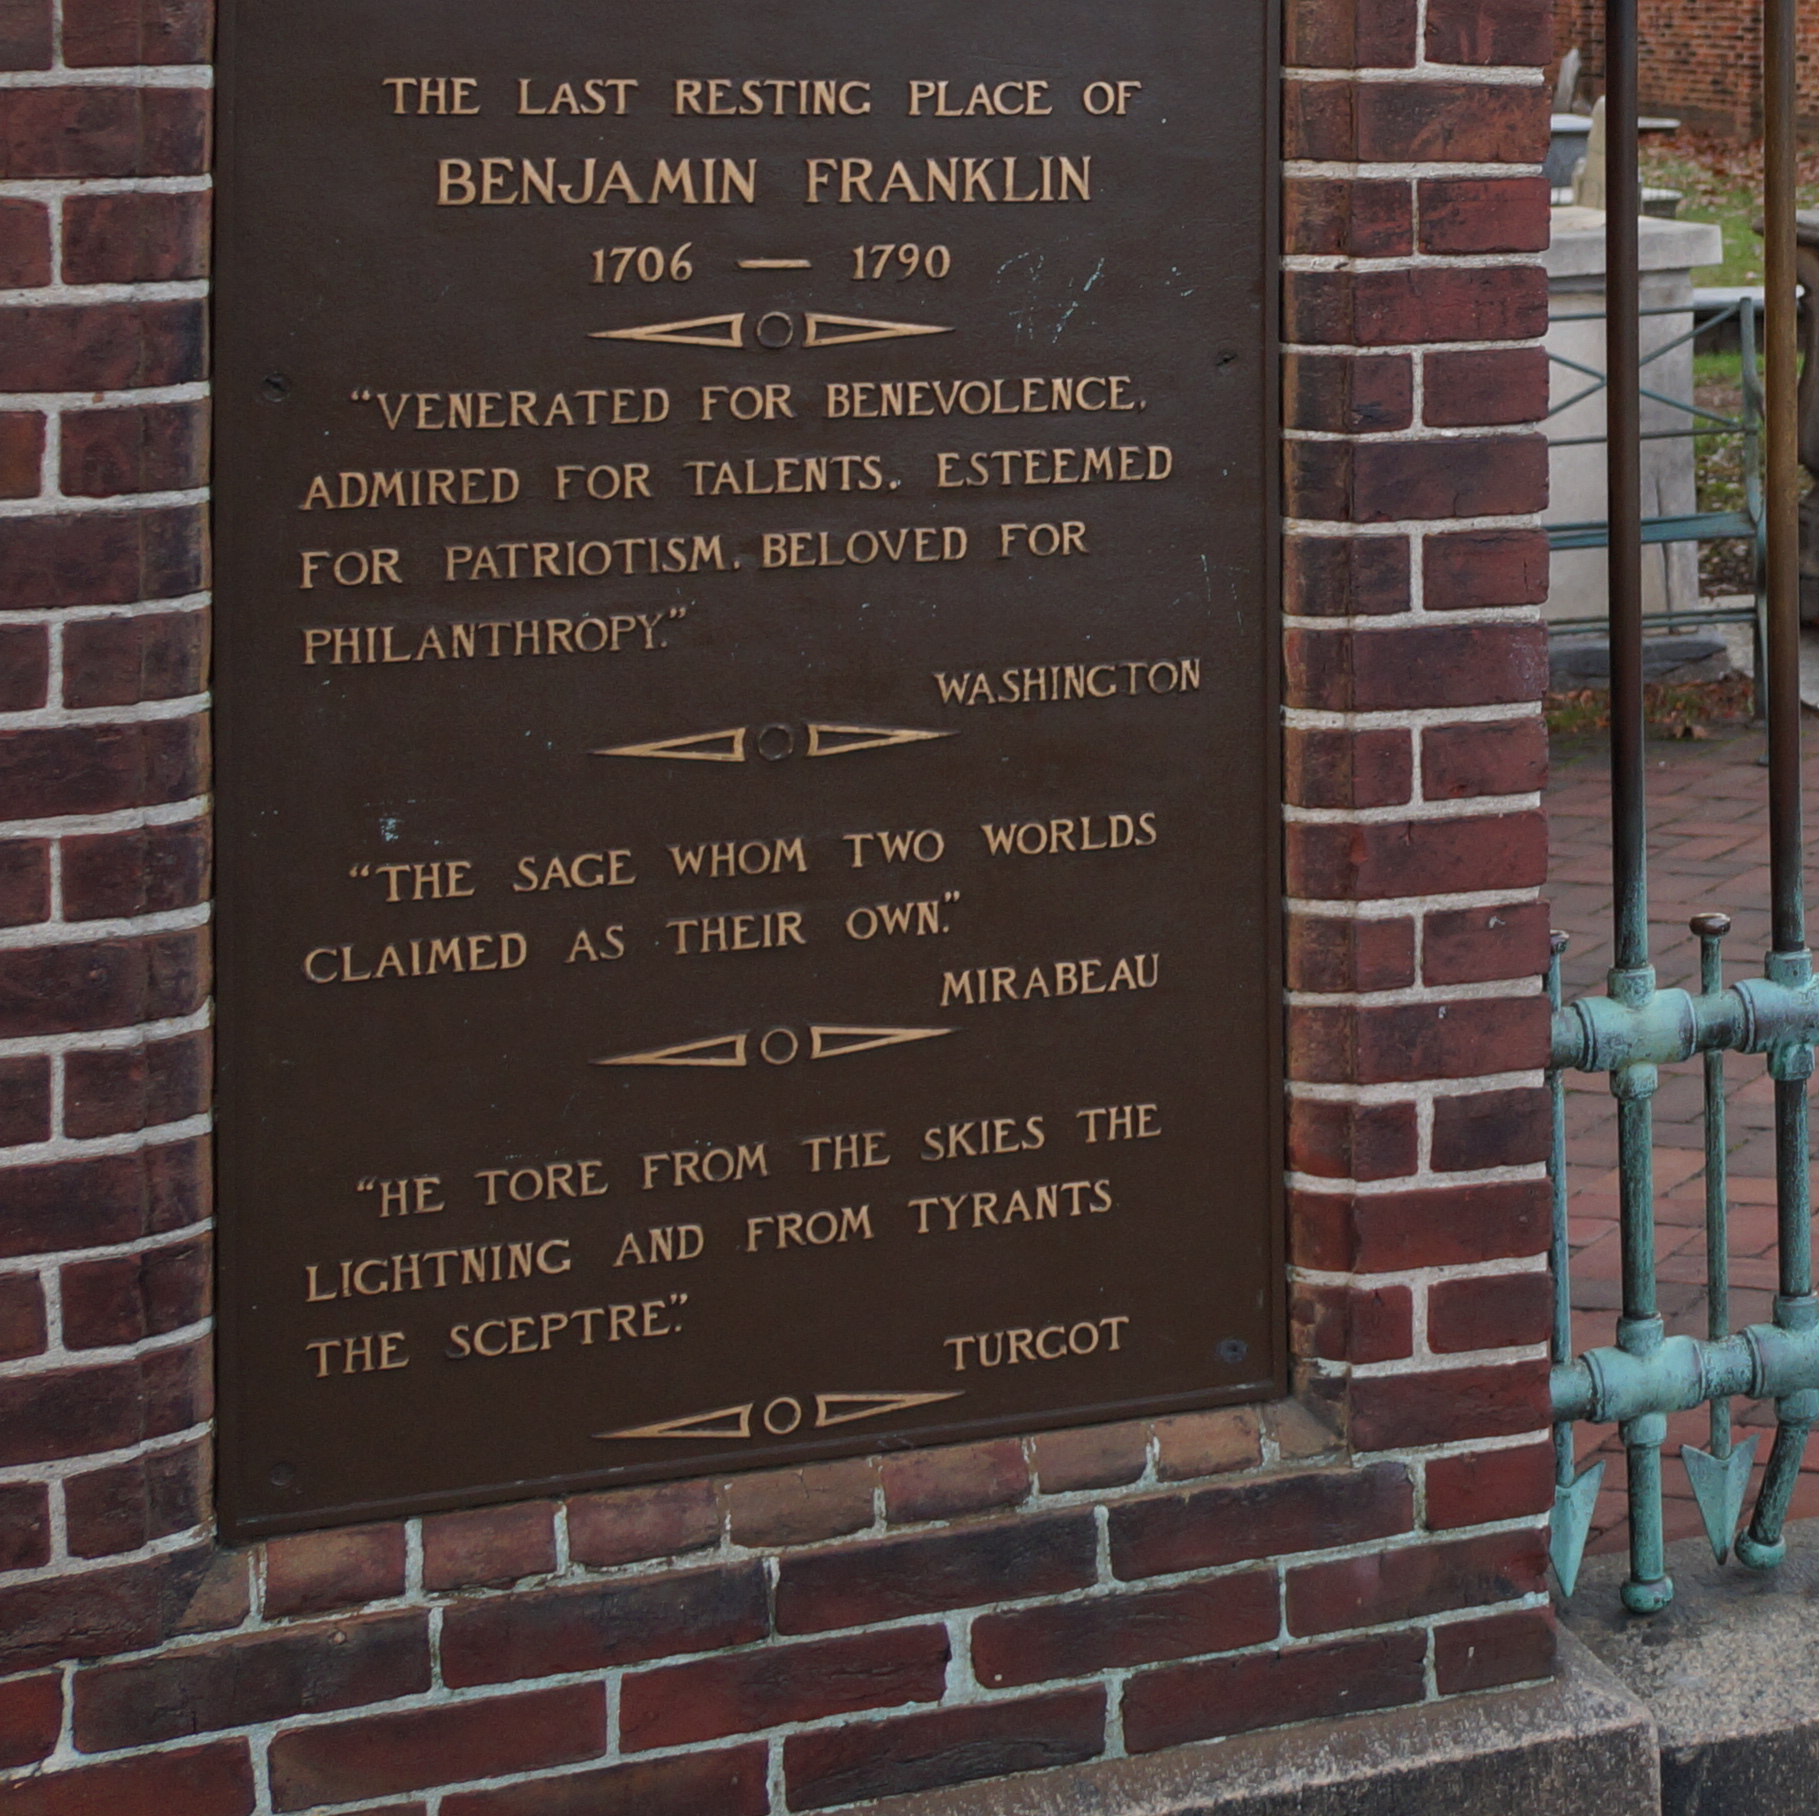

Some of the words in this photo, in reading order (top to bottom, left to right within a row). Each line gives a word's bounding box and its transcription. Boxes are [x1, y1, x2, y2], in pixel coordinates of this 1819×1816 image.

[382, 77, 480, 115] THE
[518, 78, 639, 115] LAST
[676, 78, 871, 115] RESTING
[908, 79, 1052, 117] PLACE
[1082, 80, 1142, 115] OF
[438, 157, 757, 205] BENJAMIN
[806, 155, 1091, 203] FRANKLIN
[592, 242, 693, 283] 1706
[852, 242, 951, 280] 1790
[701, 383, 794, 421] FOR
[302, 467, 520, 510] ADMIRED
[556, 462, 651, 500] FOR
[937, 445, 1173, 488] ESTEEMED
[301, 548, 403, 589] FOR
[763, 526, 968, 568] BELOVED
[1000, 520, 1087, 556] FOR
[934, 659, 1200, 706] WASHINGTON
[513, 849, 636, 892] SAGE
[669, 837, 808, 877] WHOM
[843, 829, 945, 868] TWO
[981, 812, 1157, 855] WORLDS
[304, 932, 527, 983] CLAIMED
[568, 925, 625, 962] AS
[666, 910, 806, 954] THEIR
[940, 953, 1159, 1007] MIRABEAU
[475, 1160, 608, 1205] TORE
[643, 1143, 768, 1189] FROM
[802, 1131, 890, 1172] THE
[924, 1116, 1045, 1160] SKIES
[1076, 1103, 1161, 1143] THE
[306, 1239, 571, 1302] LIGHTNING
[614, 1224, 704, 1267] AND
[747, 1205, 873, 1252] FROM
[908, 1179, 1112, 1234] TYRANTS
[306, 1331, 409, 1377] THE
[943, 1315, 1130, 1371] TURGOT
